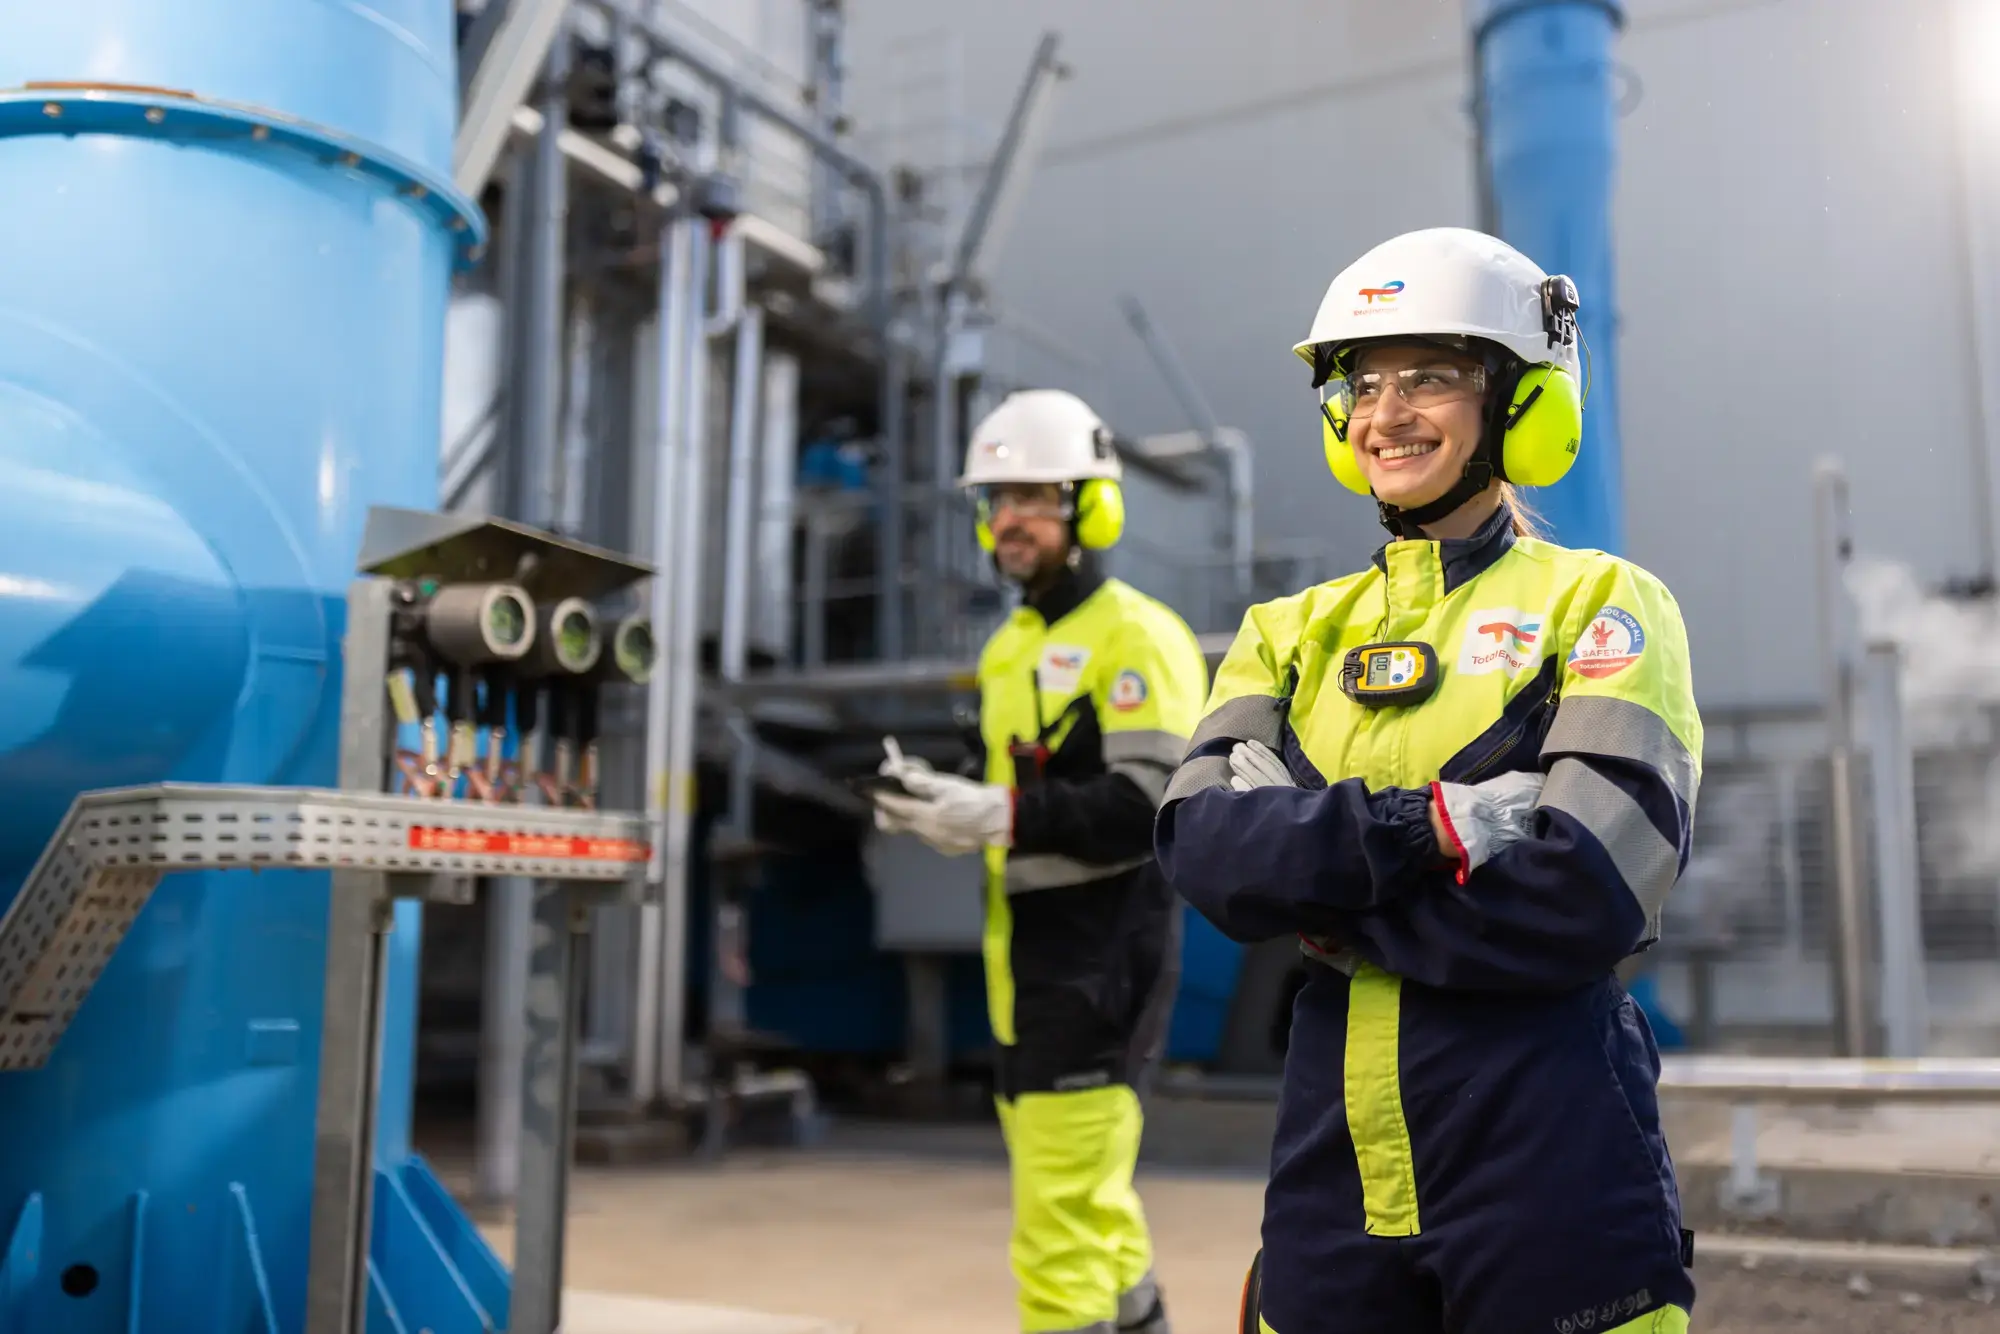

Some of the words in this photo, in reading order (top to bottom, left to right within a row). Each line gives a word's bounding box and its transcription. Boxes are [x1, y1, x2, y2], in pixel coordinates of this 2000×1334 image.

[1621, 614, 1637, 629] FOR
[1633, 629, 1642, 643] ALL
[1471, 650, 1525, 669] TotalEner
[1582, 648, 1625, 657] SAFETY
